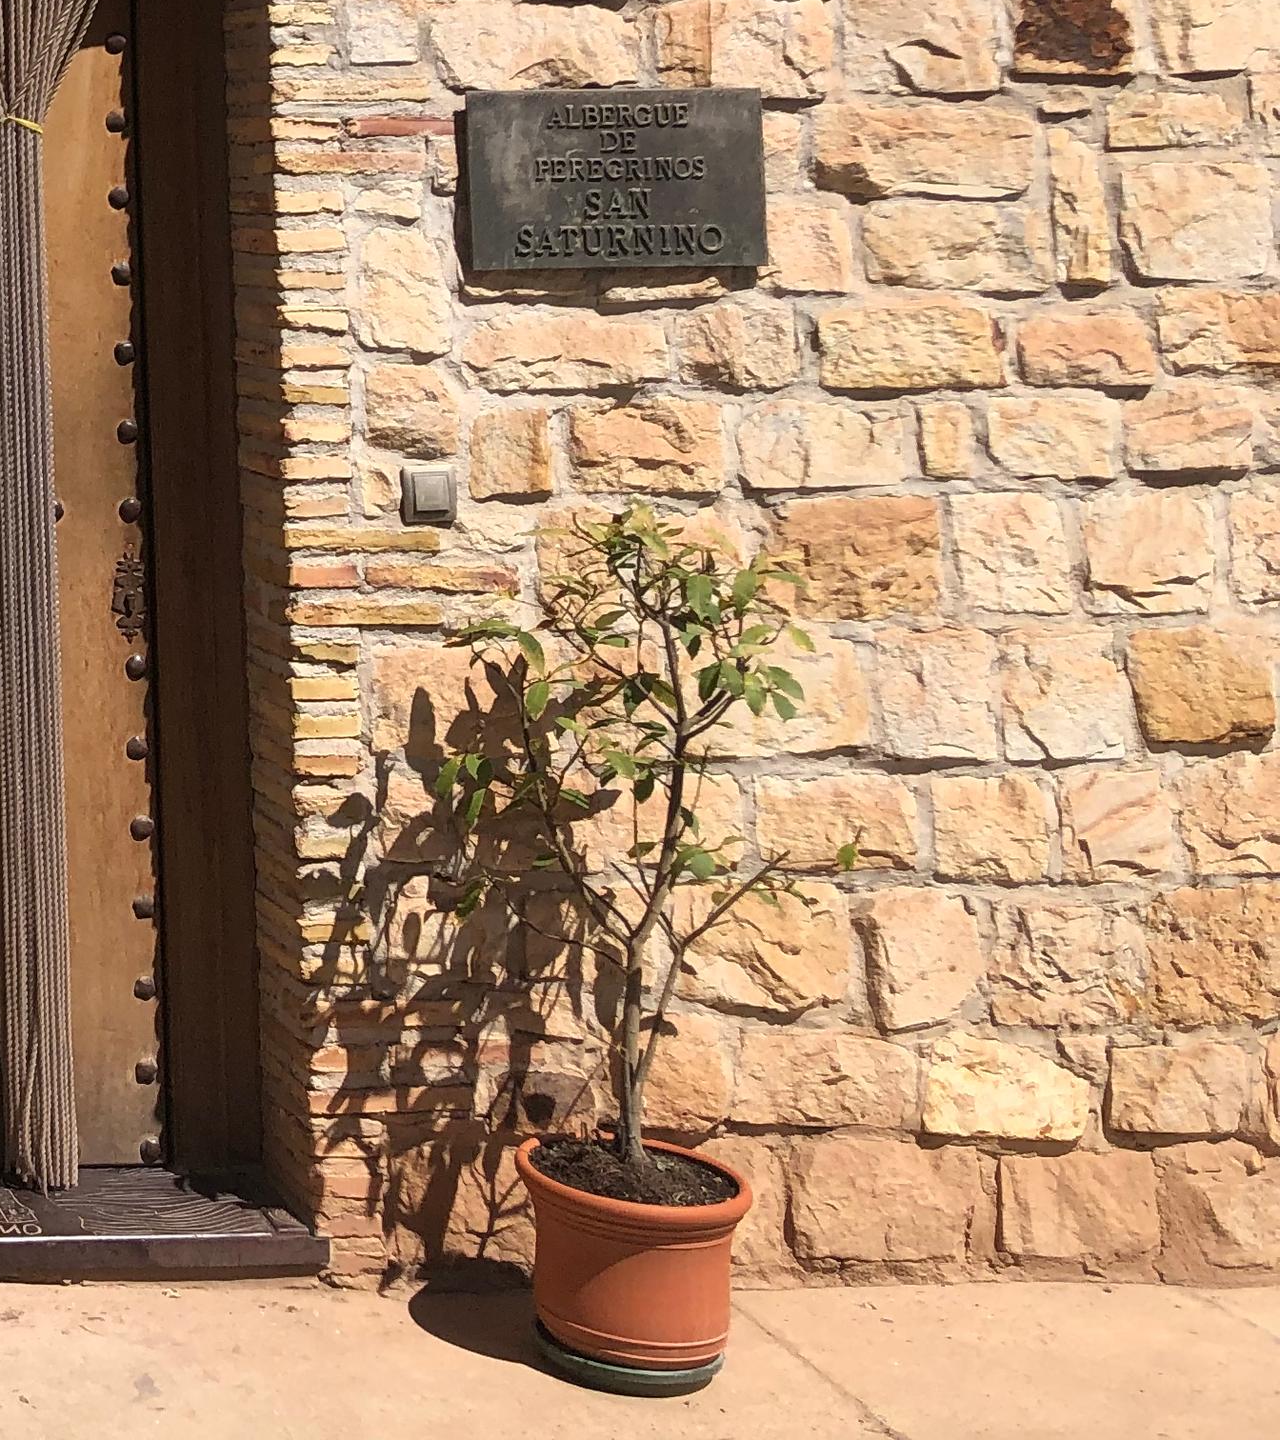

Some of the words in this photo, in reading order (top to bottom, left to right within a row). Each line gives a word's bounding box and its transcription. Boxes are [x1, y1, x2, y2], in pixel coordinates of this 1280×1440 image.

[546, 102, 690, 129] ALBERGUE
[599, 130, 637, 153] DE
[534, 156, 705, 182] PEREGRINOS
[583, 187, 652, 220] SAN
[513, 224, 726, 258] SATURNINO
